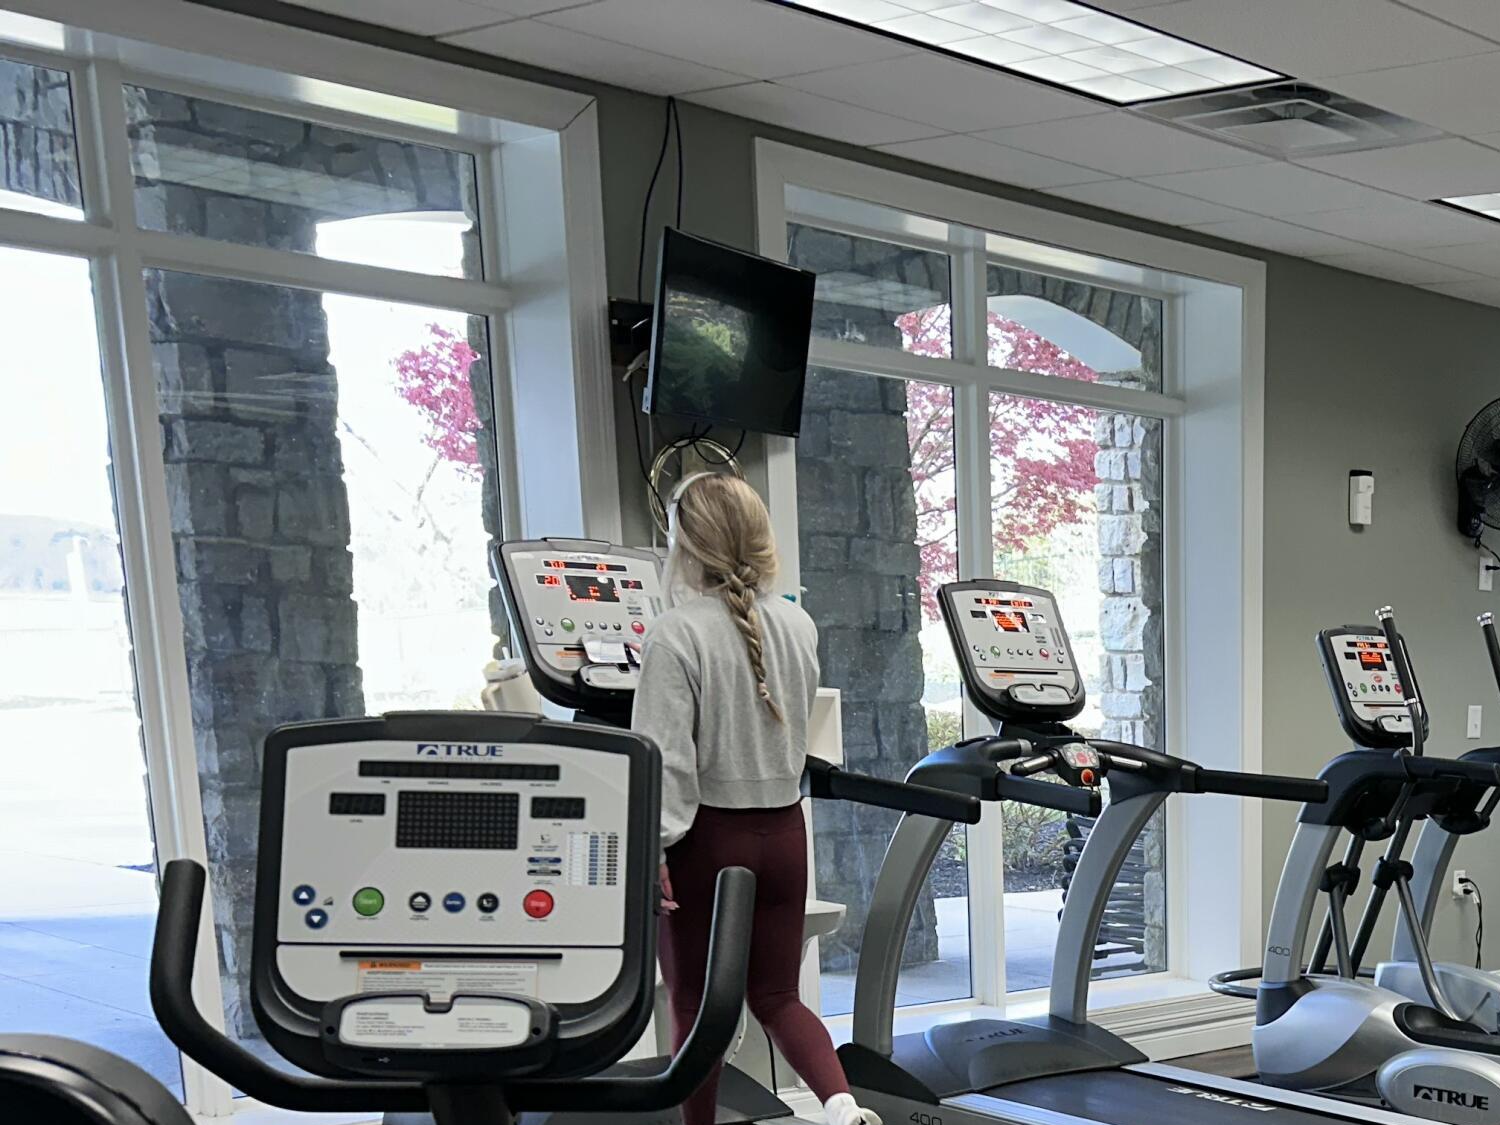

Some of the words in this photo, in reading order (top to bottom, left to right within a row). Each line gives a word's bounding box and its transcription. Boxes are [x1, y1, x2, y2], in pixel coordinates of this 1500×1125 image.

[440, 744, 504, 757] TRUE
[1268, 946, 1291, 957] 400
[1432, 1087, 1489, 1111] TRUE
